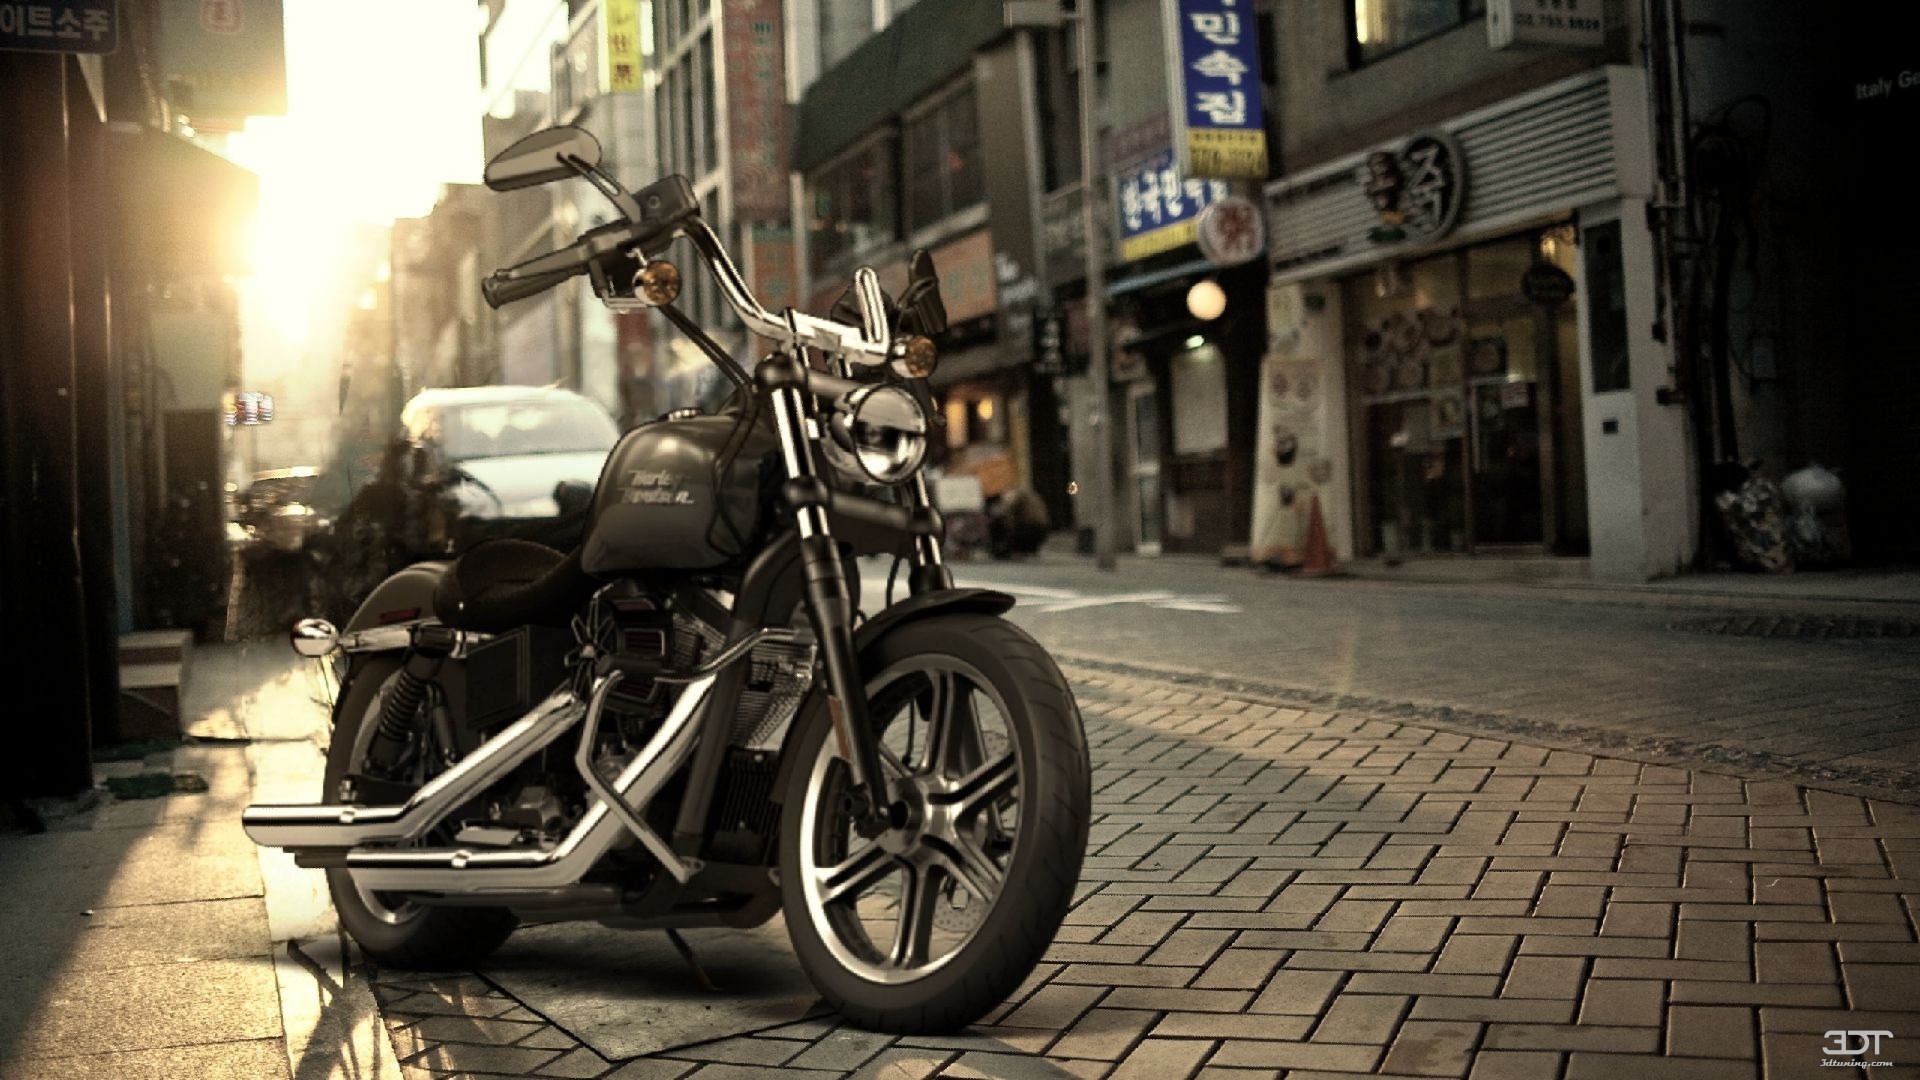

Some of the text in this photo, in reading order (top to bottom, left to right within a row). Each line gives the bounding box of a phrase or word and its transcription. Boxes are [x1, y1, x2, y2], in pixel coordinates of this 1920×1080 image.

[0, 5, 109, 41] 이트소주
[1187, 0, 1248, 125] 민속집
[1855, 76, 1892, 101] Italy
